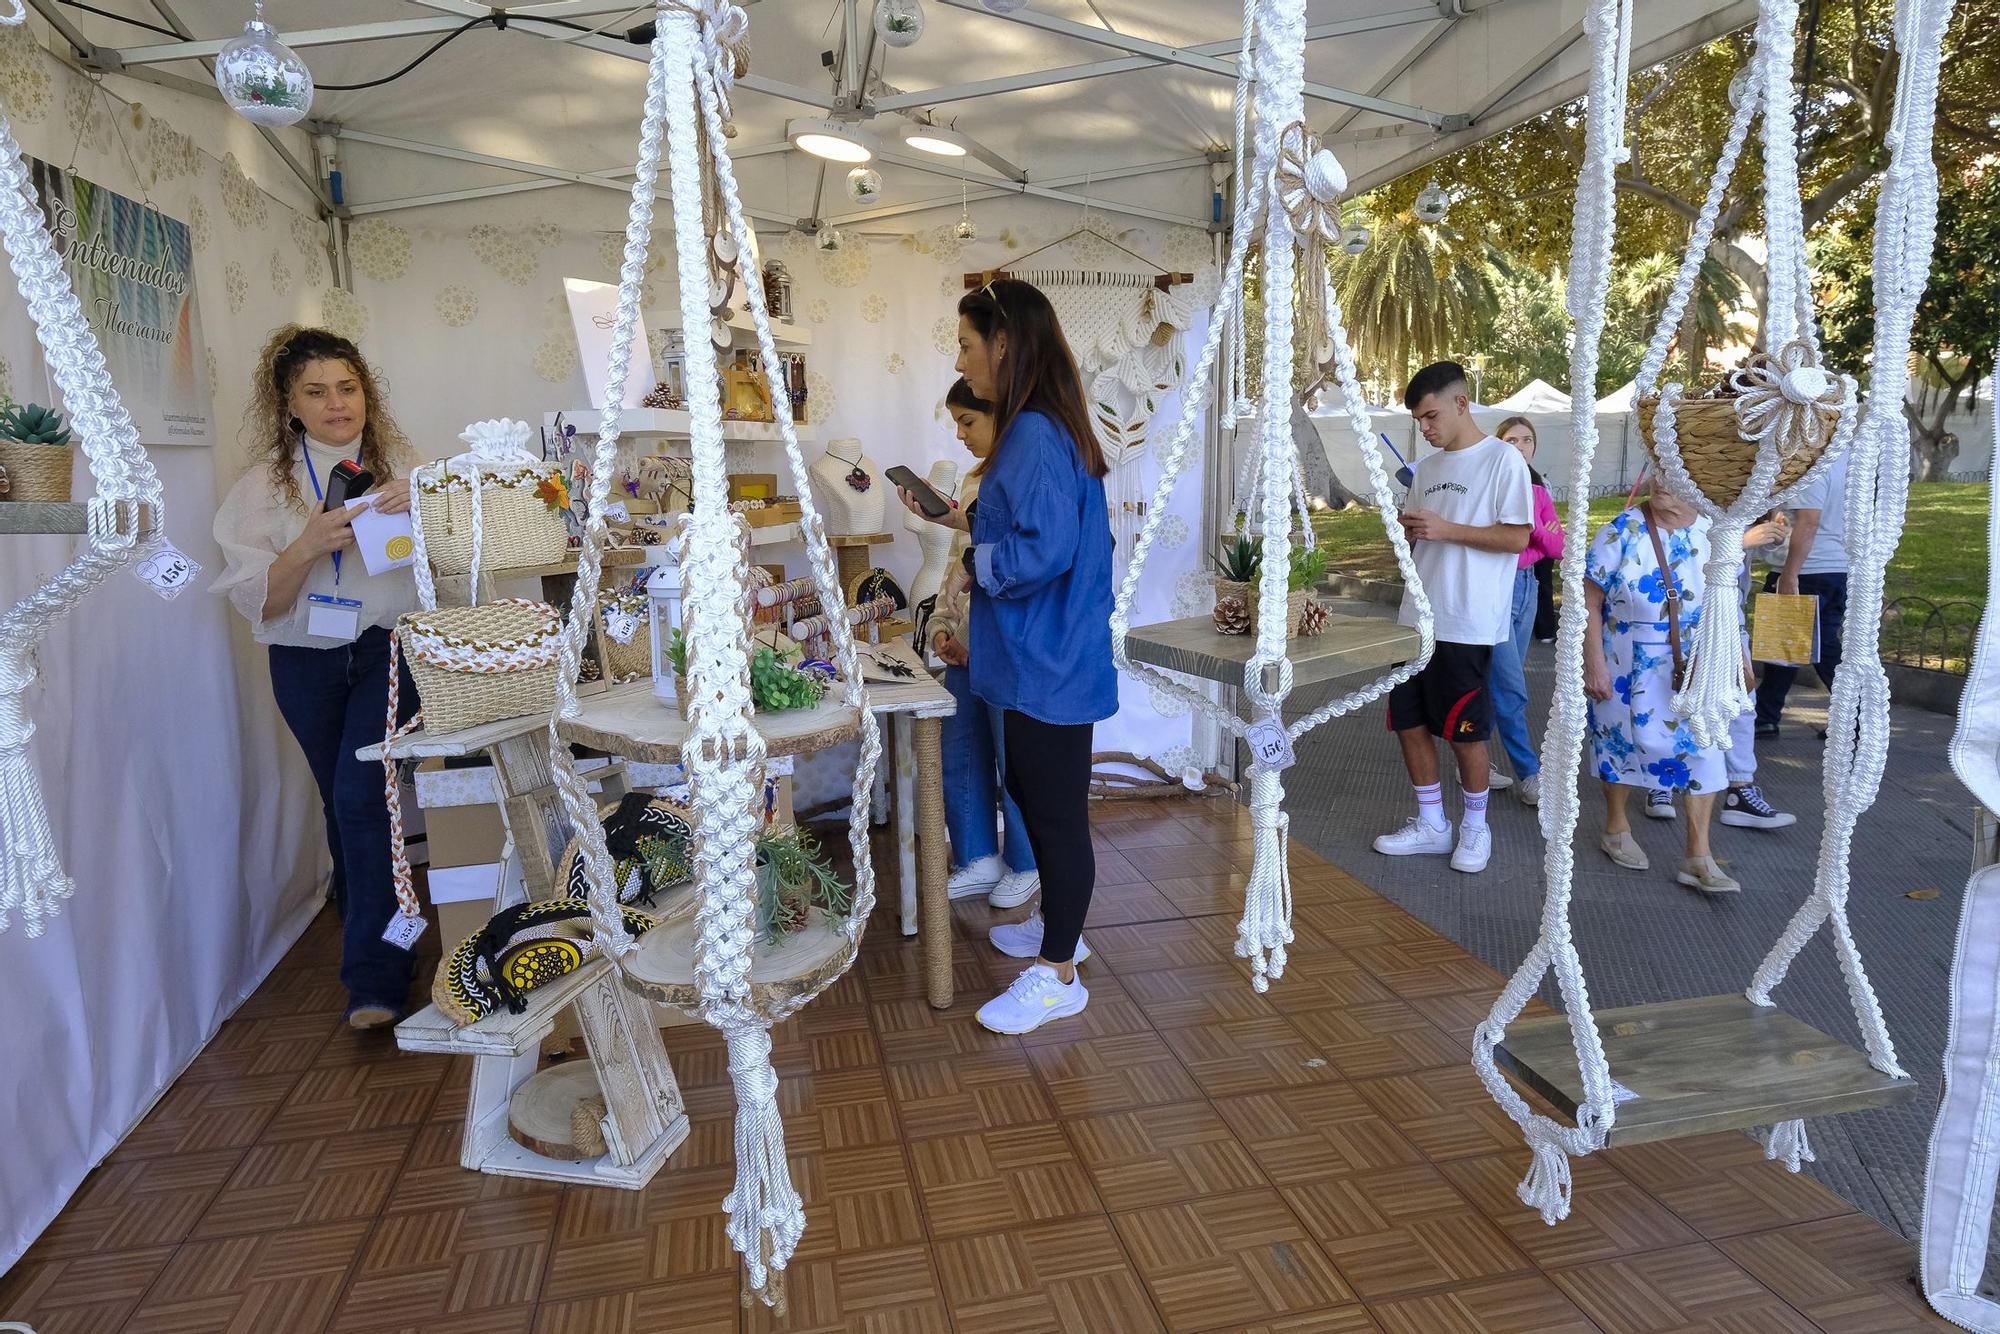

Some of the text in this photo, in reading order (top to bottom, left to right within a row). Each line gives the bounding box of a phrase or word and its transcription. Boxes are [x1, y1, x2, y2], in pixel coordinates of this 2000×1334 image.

[51, 199, 186, 296] Entrenudos
[86, 298, 174, 345] Macramé
[161, 560, 187, 585] 45€
[400, 920, 417, 940] 35€
